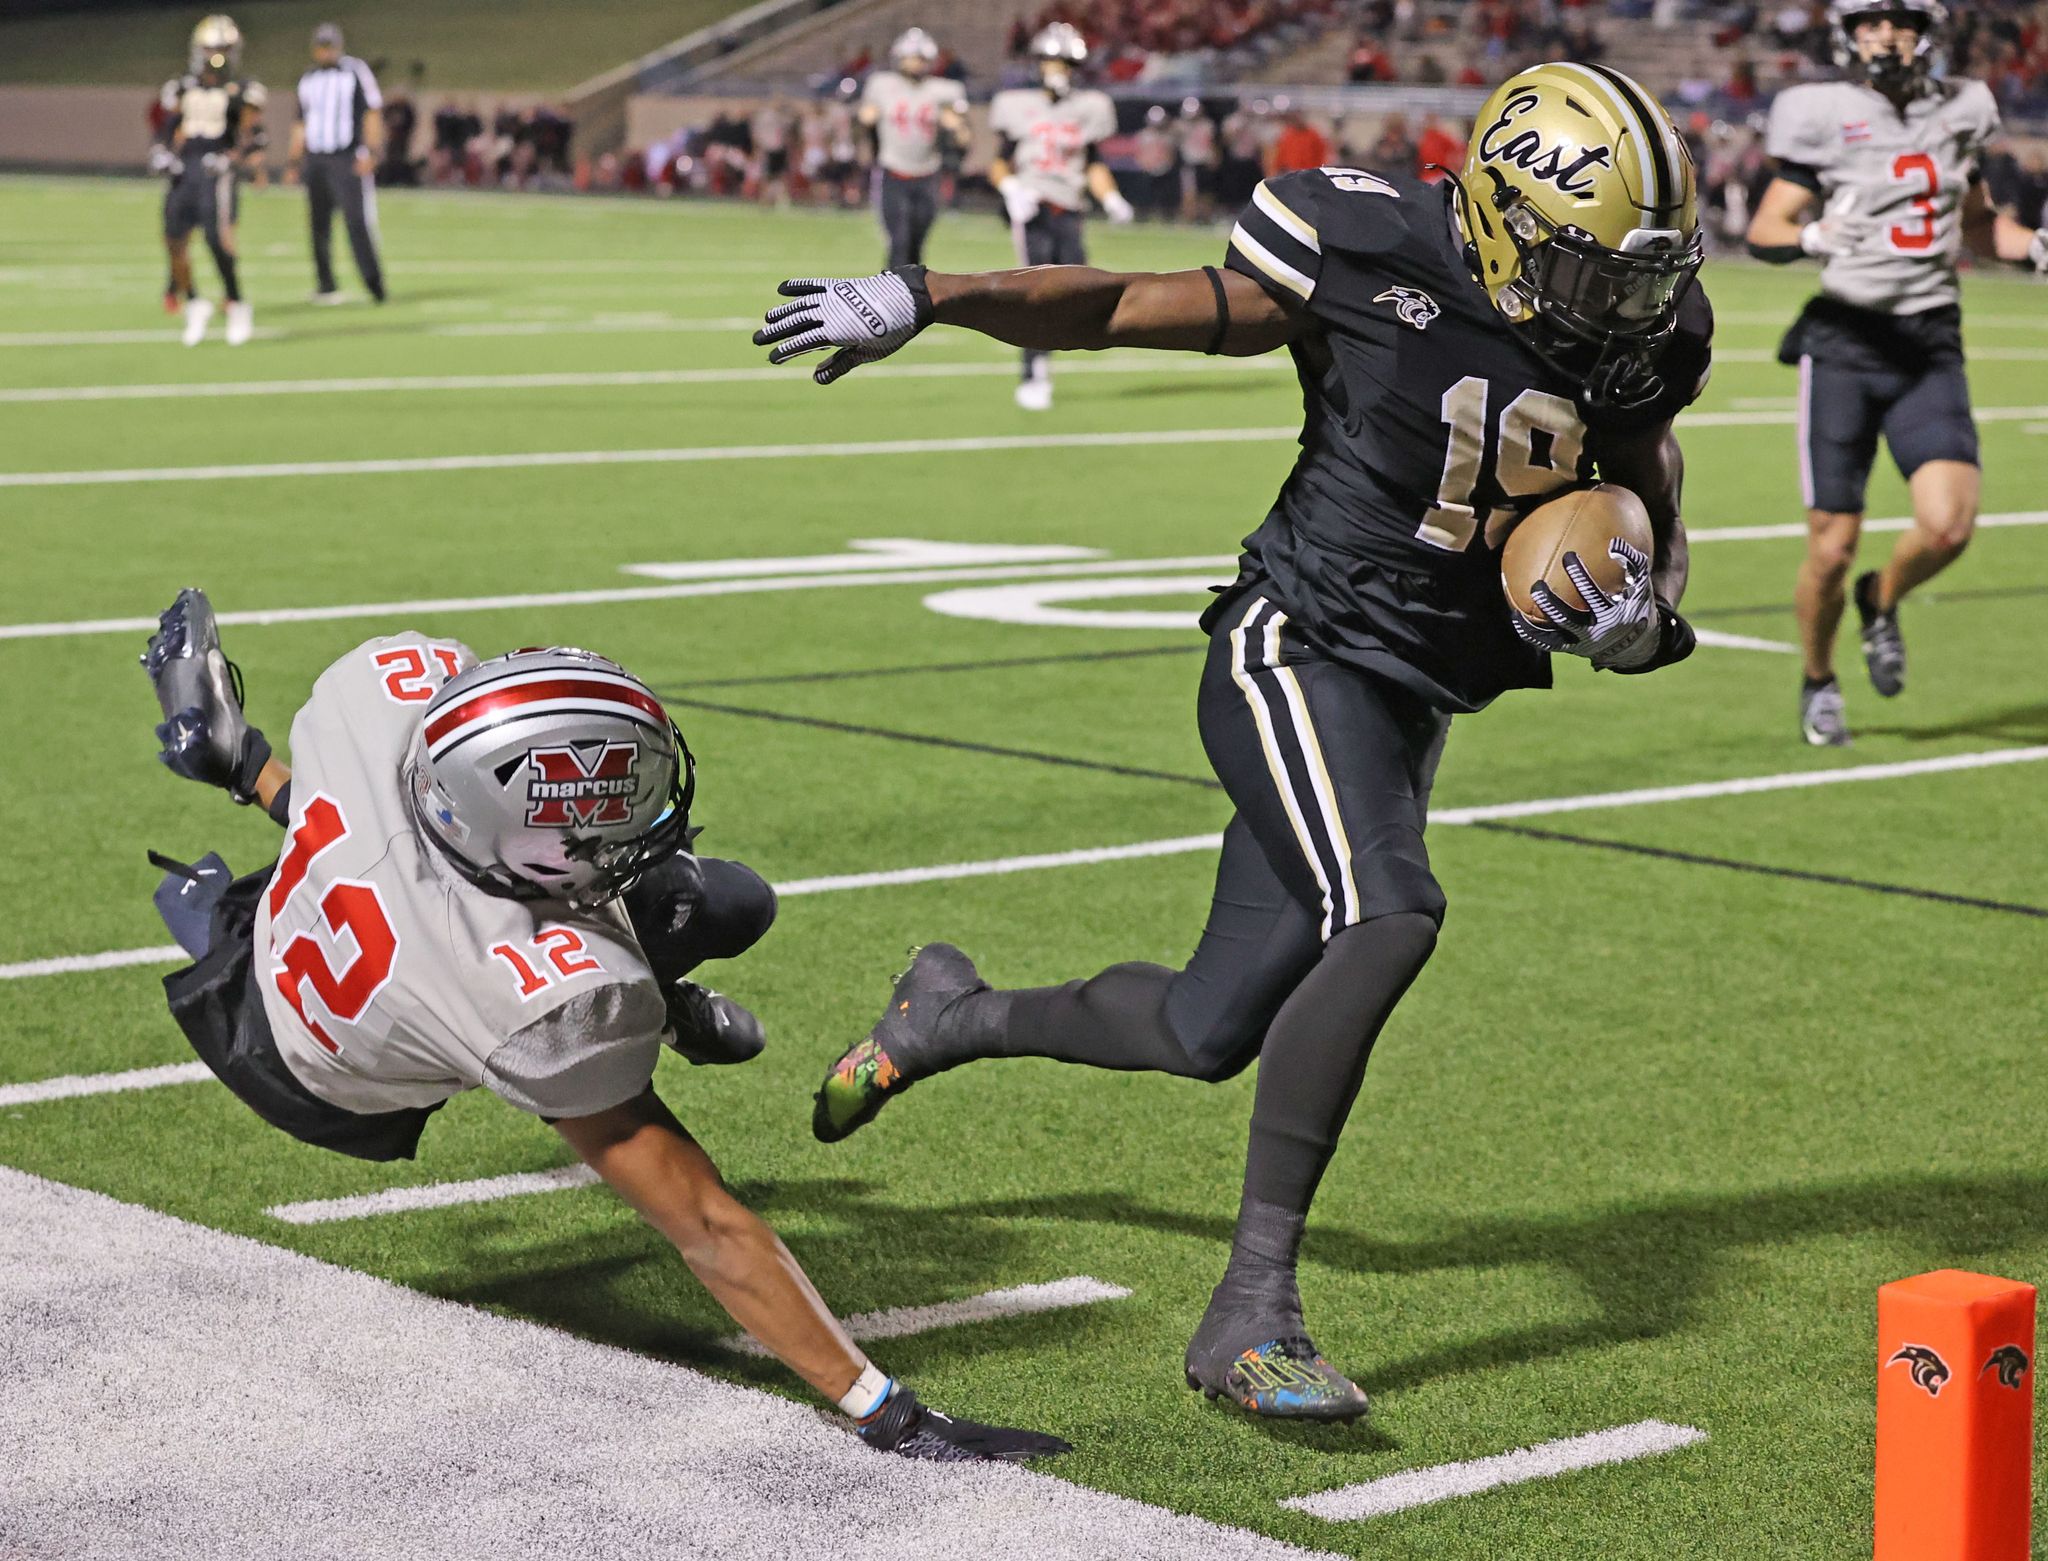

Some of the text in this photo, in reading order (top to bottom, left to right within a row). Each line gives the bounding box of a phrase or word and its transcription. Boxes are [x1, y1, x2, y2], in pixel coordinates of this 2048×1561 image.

[1478, 93, 1612, 194] East
[1888, 150, 1943, 257] 3
[837, 283, 882, 330] BATTLE
[524, 741, 640, 830] M
[530, 778, 637, 799] marcus
[269, 790, 400, 1057] 12
[487, 924, 609, 1003] 12
